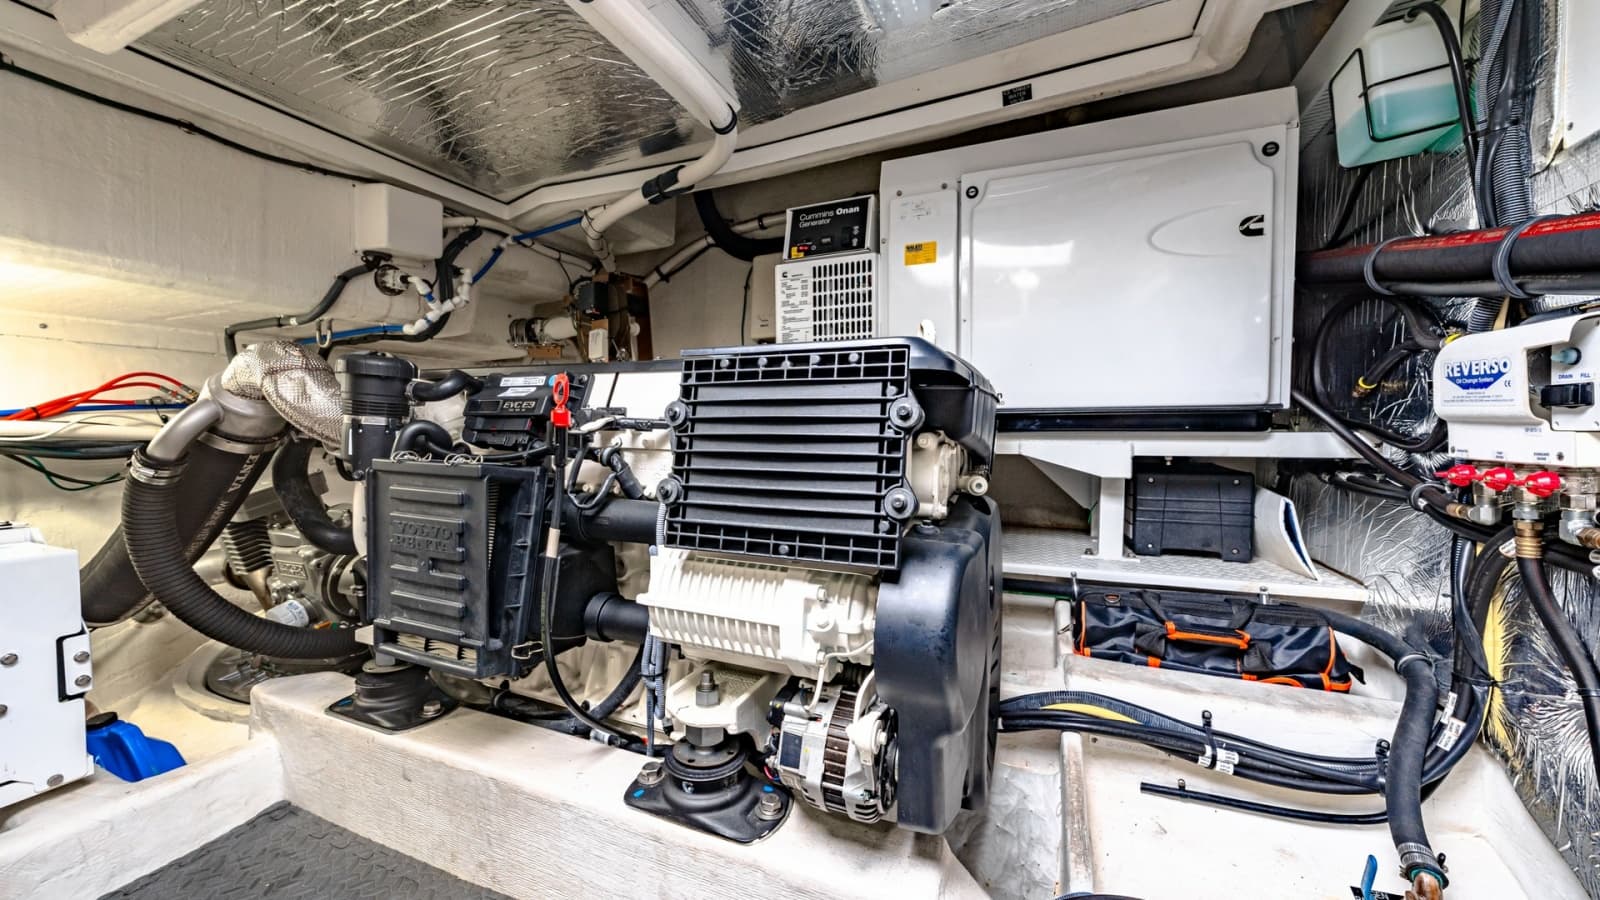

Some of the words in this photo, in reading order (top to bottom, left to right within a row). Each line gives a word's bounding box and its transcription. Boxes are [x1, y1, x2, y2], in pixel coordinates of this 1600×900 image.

[800, 210, 834, 221] Cummins
[836, 206, 860, 215] Onan
[799, 218, 831, 228] Generator
[1444, 359, 1510, 377] REVERSO
[227, 454, 261, 493] ENTA
